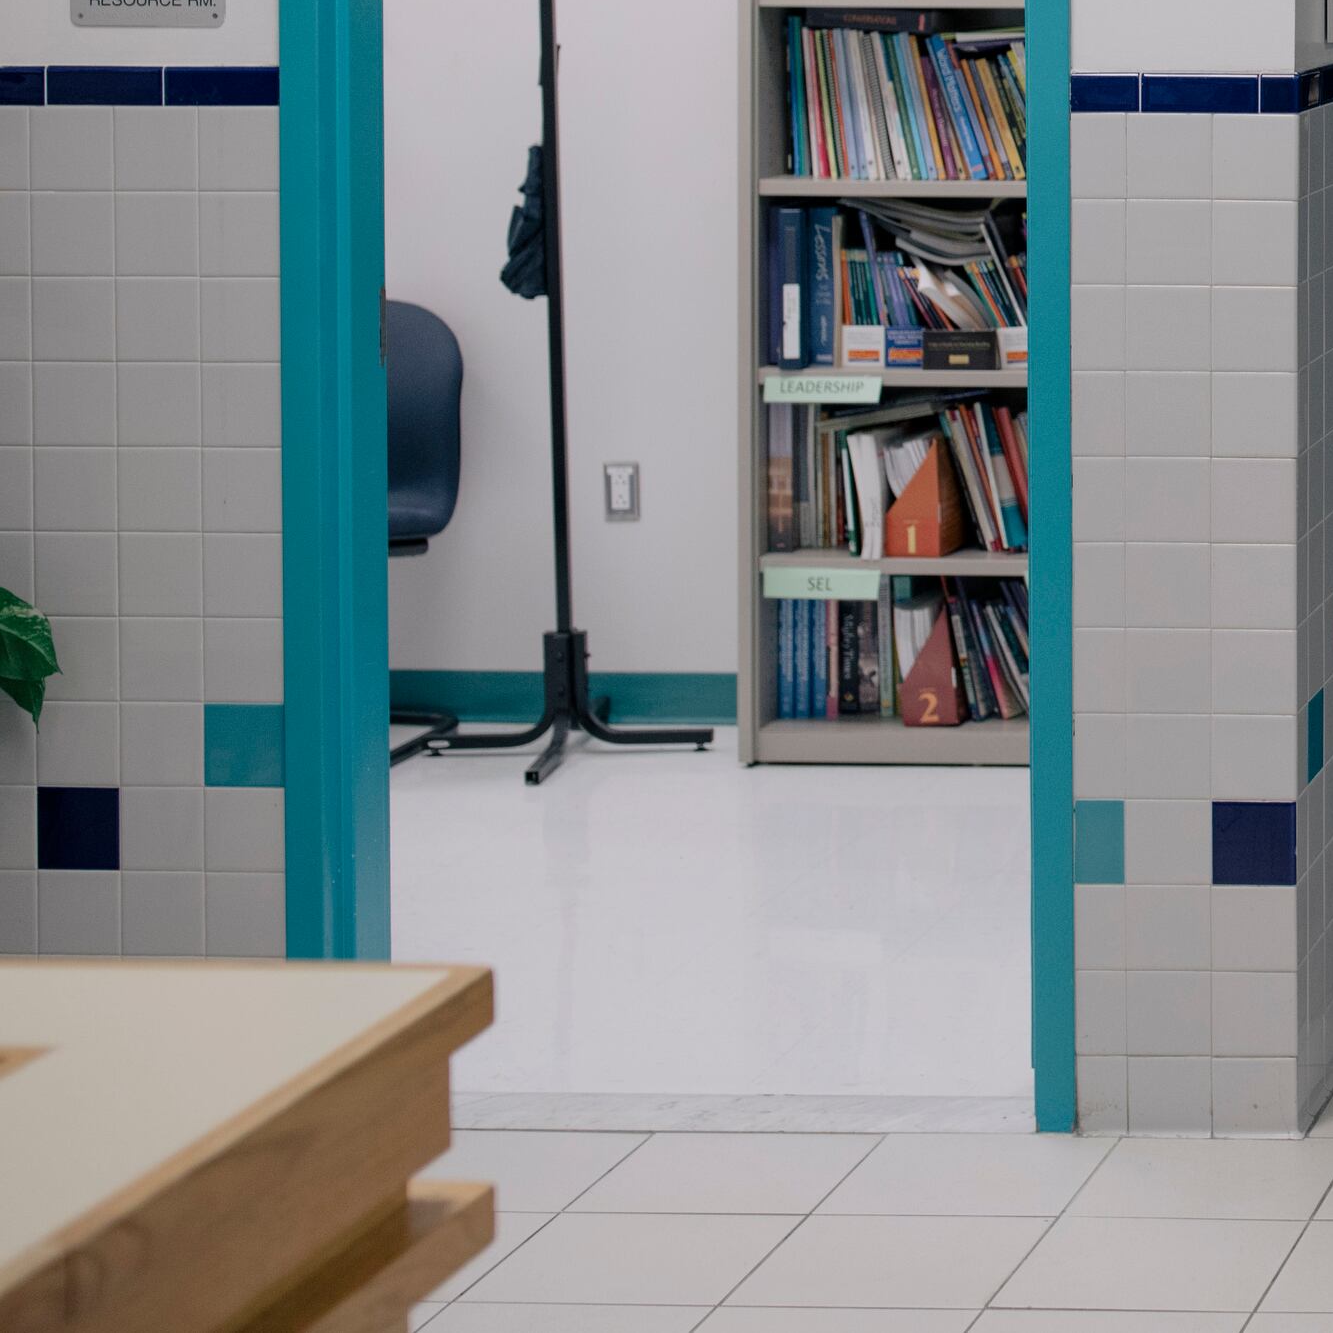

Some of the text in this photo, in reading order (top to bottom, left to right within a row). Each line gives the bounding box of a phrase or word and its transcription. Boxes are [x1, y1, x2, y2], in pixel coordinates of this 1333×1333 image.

[780, 382, 864, 393] LEADERSHIP
[906, 525, 916, 554] 1
[808, 578, 832, 591] SEL
[919, 694, 939, 722] 2
